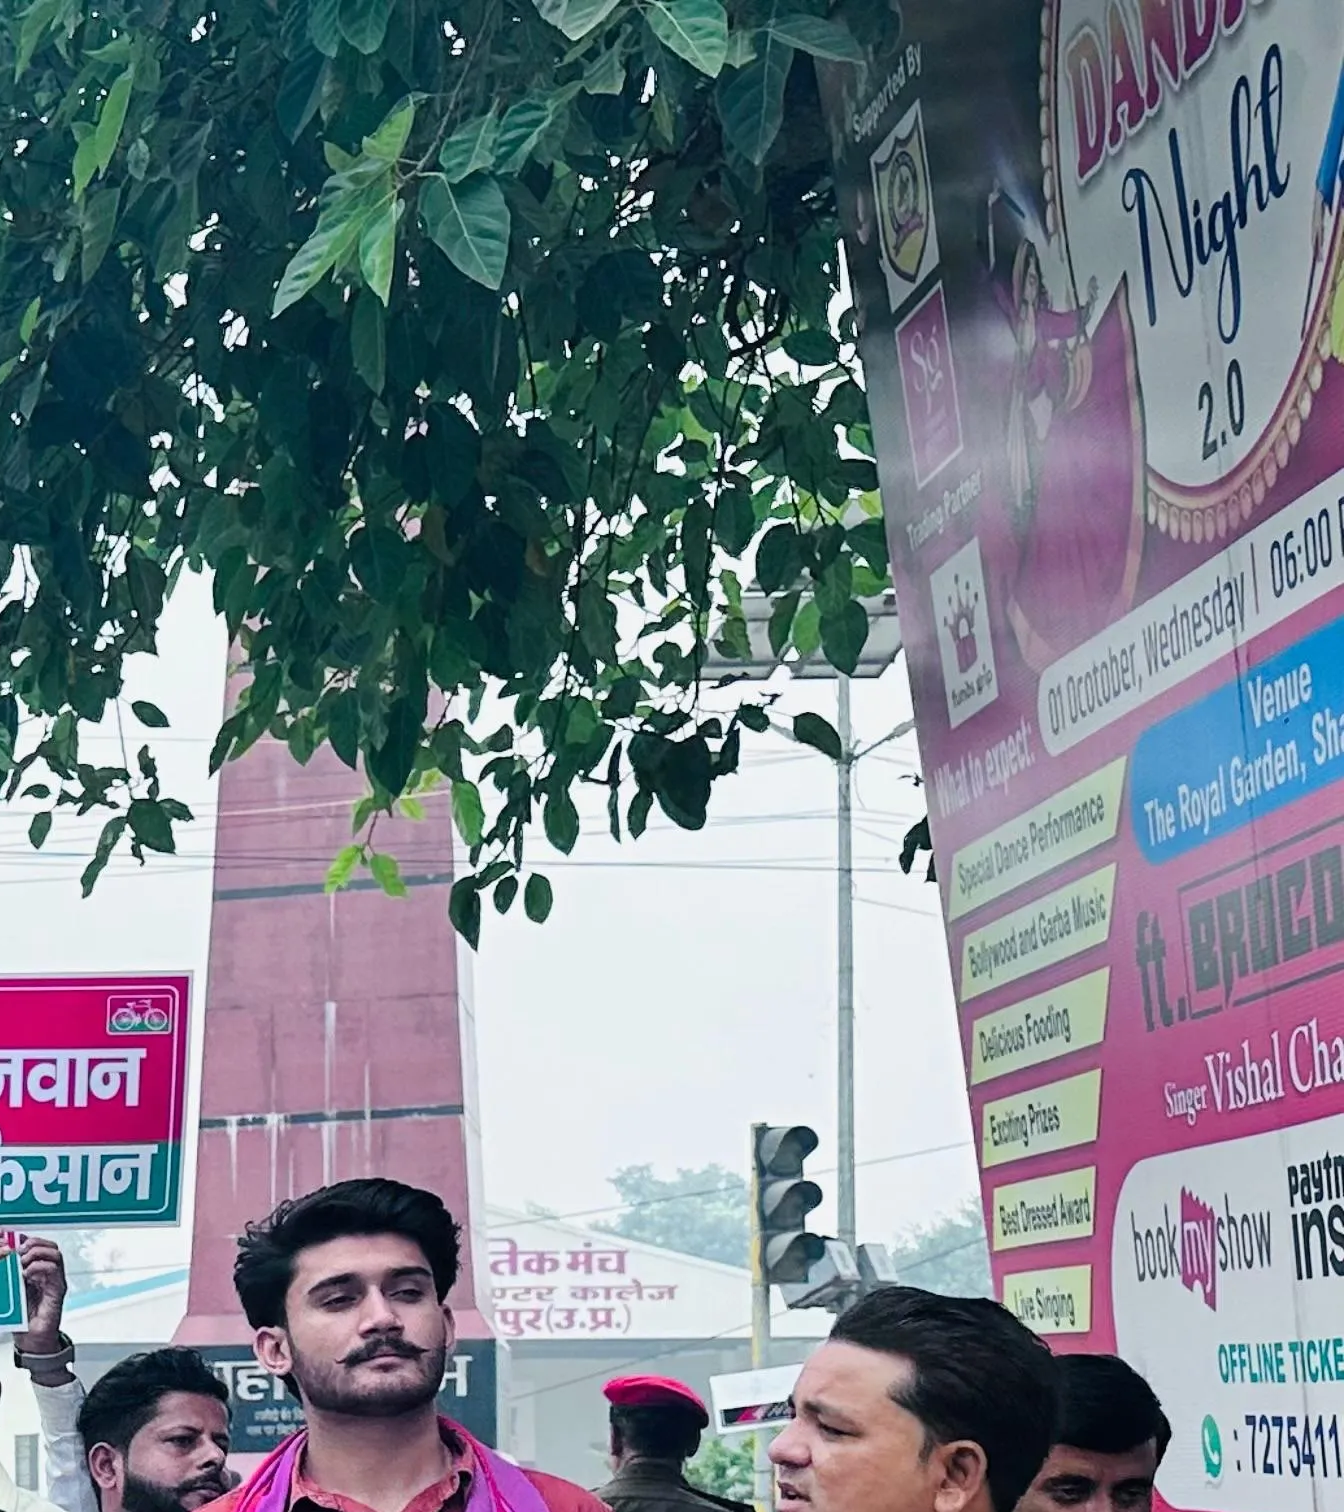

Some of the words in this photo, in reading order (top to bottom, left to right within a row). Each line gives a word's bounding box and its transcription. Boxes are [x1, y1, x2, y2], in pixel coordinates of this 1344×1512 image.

[853, 71, 906, 144] Supported
[904, 43, 923, 80] By
[1121, 43, 1291, 344] Night
[1197, 357, 1246, 462] 2.0
[1047, 683, 1066, 737] 01
[1142, 572, 1245, 678] Wednesday
[1269, 508, 1332, 599] 06:00
[1247, 662, 1312, 729] Venue
[933, 755, 970, 820] What
[967, 750, 985, 799] to
[1144, 797, 1176, 847] The
[1177, 763, 1227, 836] Royal
[1230, 738, 1308, 807] Garden,
[957, 849, 996, 899] Special
[994, 834, 1029, 876] Dance
[1028, 793, 1106, 857] Performance
[967, 926, 1019, 980] Bollywood
[1018, 915, 1039, 957] and
[1038, 904, 1072, 948] Garba
[1070, 886, 1107, 932] Music
[1135, 909, 1188, 1033] ft.
[978, 1023, 1026, 1063] Delicious
[1024, 1003, 1072, 1048] Fooding
[1164, 1080, 1208, 1126] Singer
[1203, 1031, 1285, 1113] Vishal
[989, 1110, 1029, 1148] Exciting
[1027, 1100, 1061, 1137] Prizes
[565, 1241, 629, 1275] मंच
[998, 1200, 1022, 1237] Best
[1019, 1194, 1060, 1233] Dressed
[1059, 1187, 1091, 1227] Award
[1014, 1288, 1036, 1322] Live
[1034, 1285, 1076, 1328] Singing
[1218, 1341, 1287, 1384] OFFLINE
